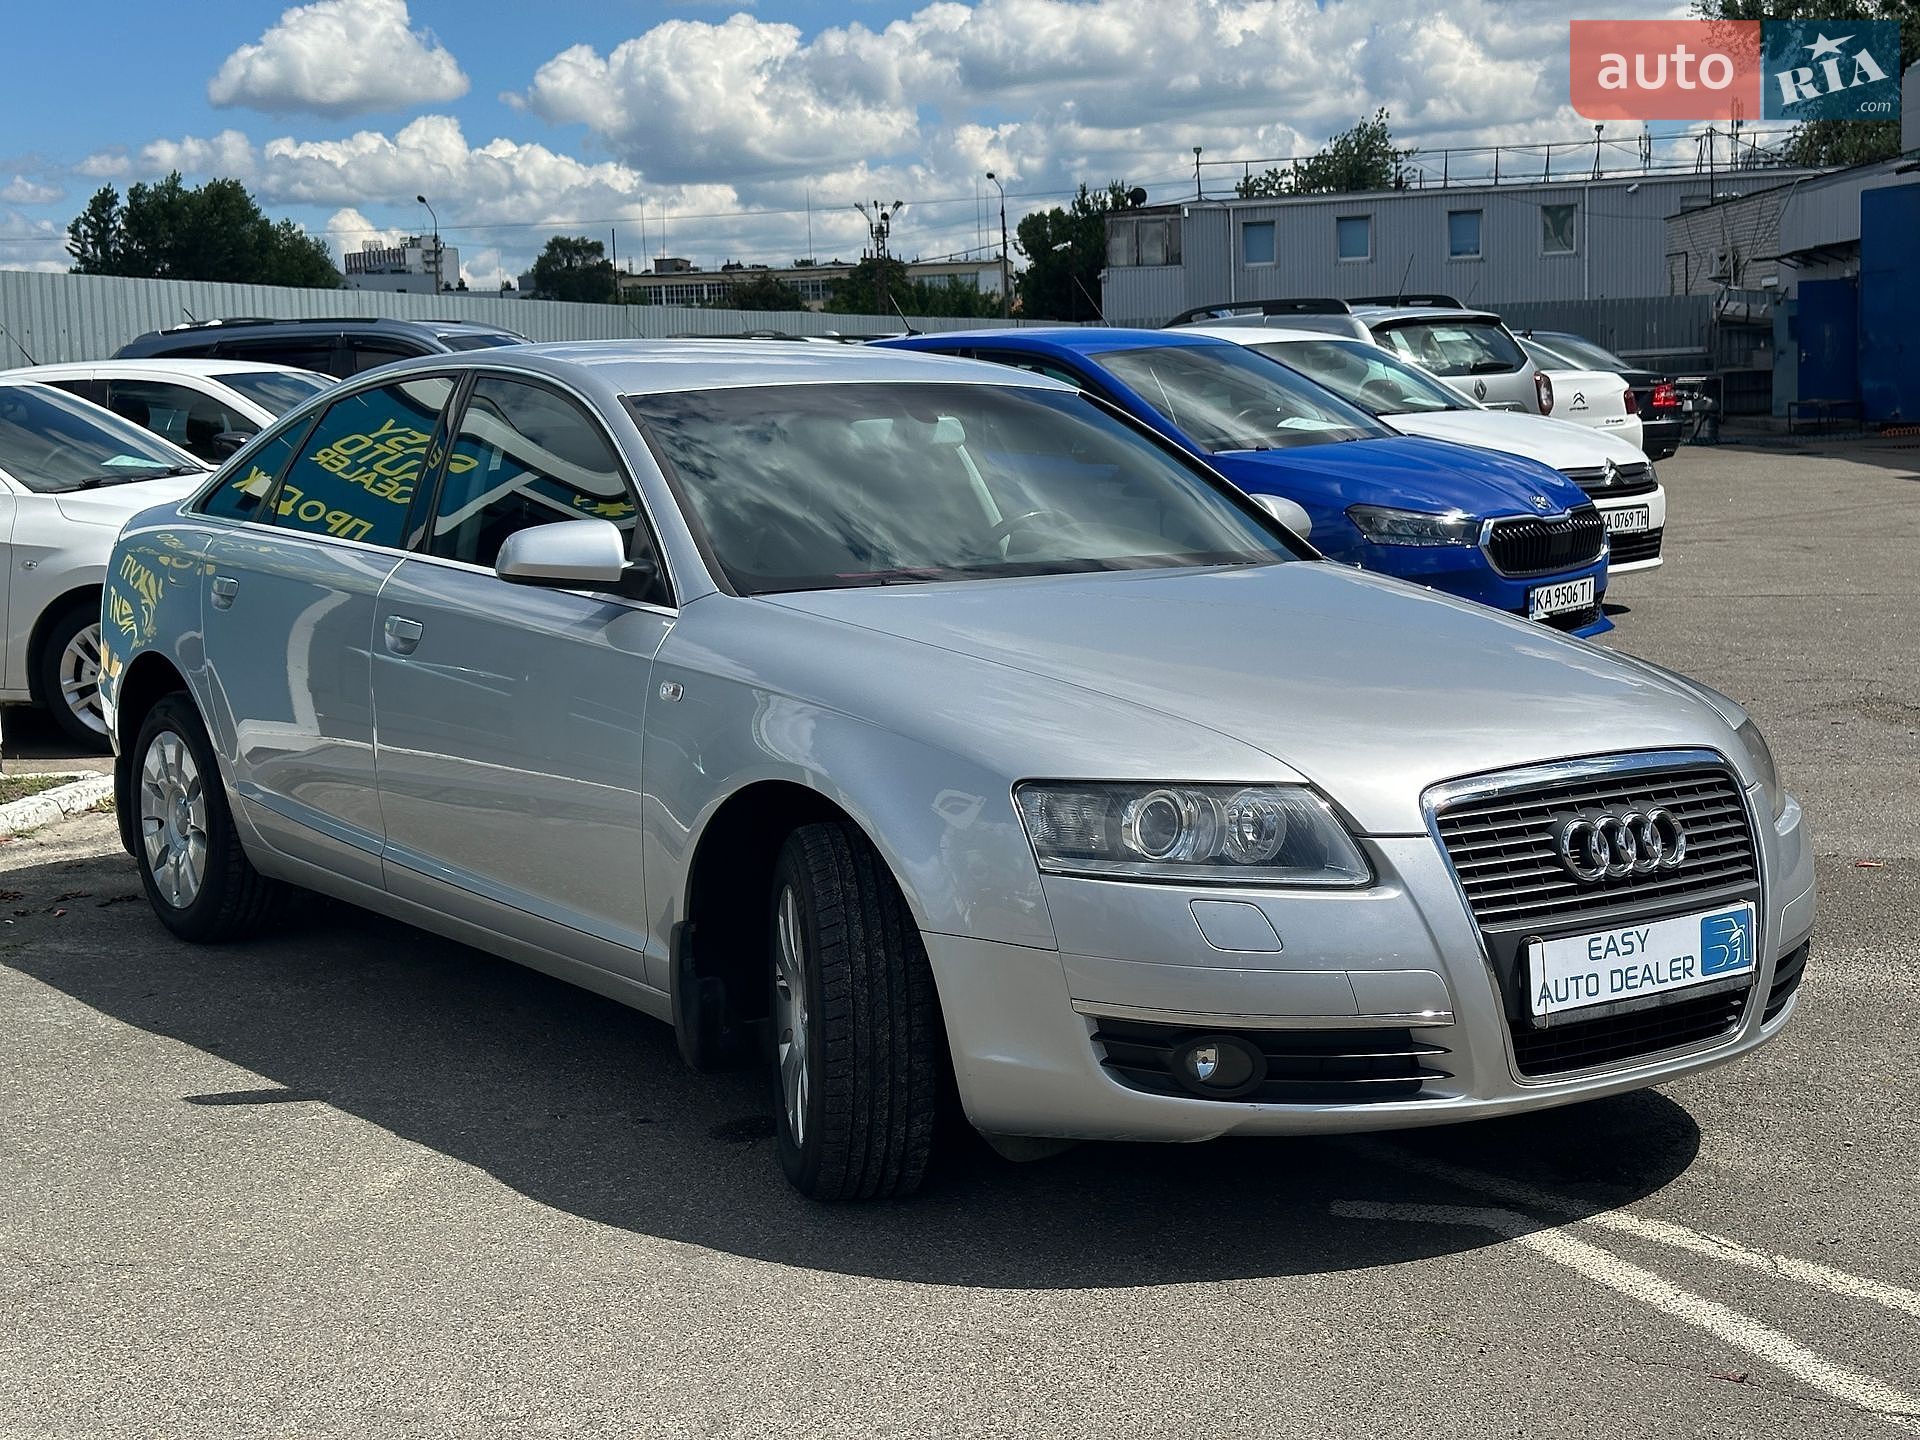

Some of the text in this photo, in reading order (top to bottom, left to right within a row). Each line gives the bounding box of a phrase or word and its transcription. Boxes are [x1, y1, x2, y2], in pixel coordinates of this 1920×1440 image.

[1614, 511, 1634, 528] 0769
[1636, 510, 1647, 526] TH
[1536, 589, 1552, 611] KA
[1554, 583, 1579, 608] 9506
[1580, 580, 1592, 602] TI
[1587, 928, 1651, 962] EASY
[1537, 955, 1695, 1007] AUTO DEALER
